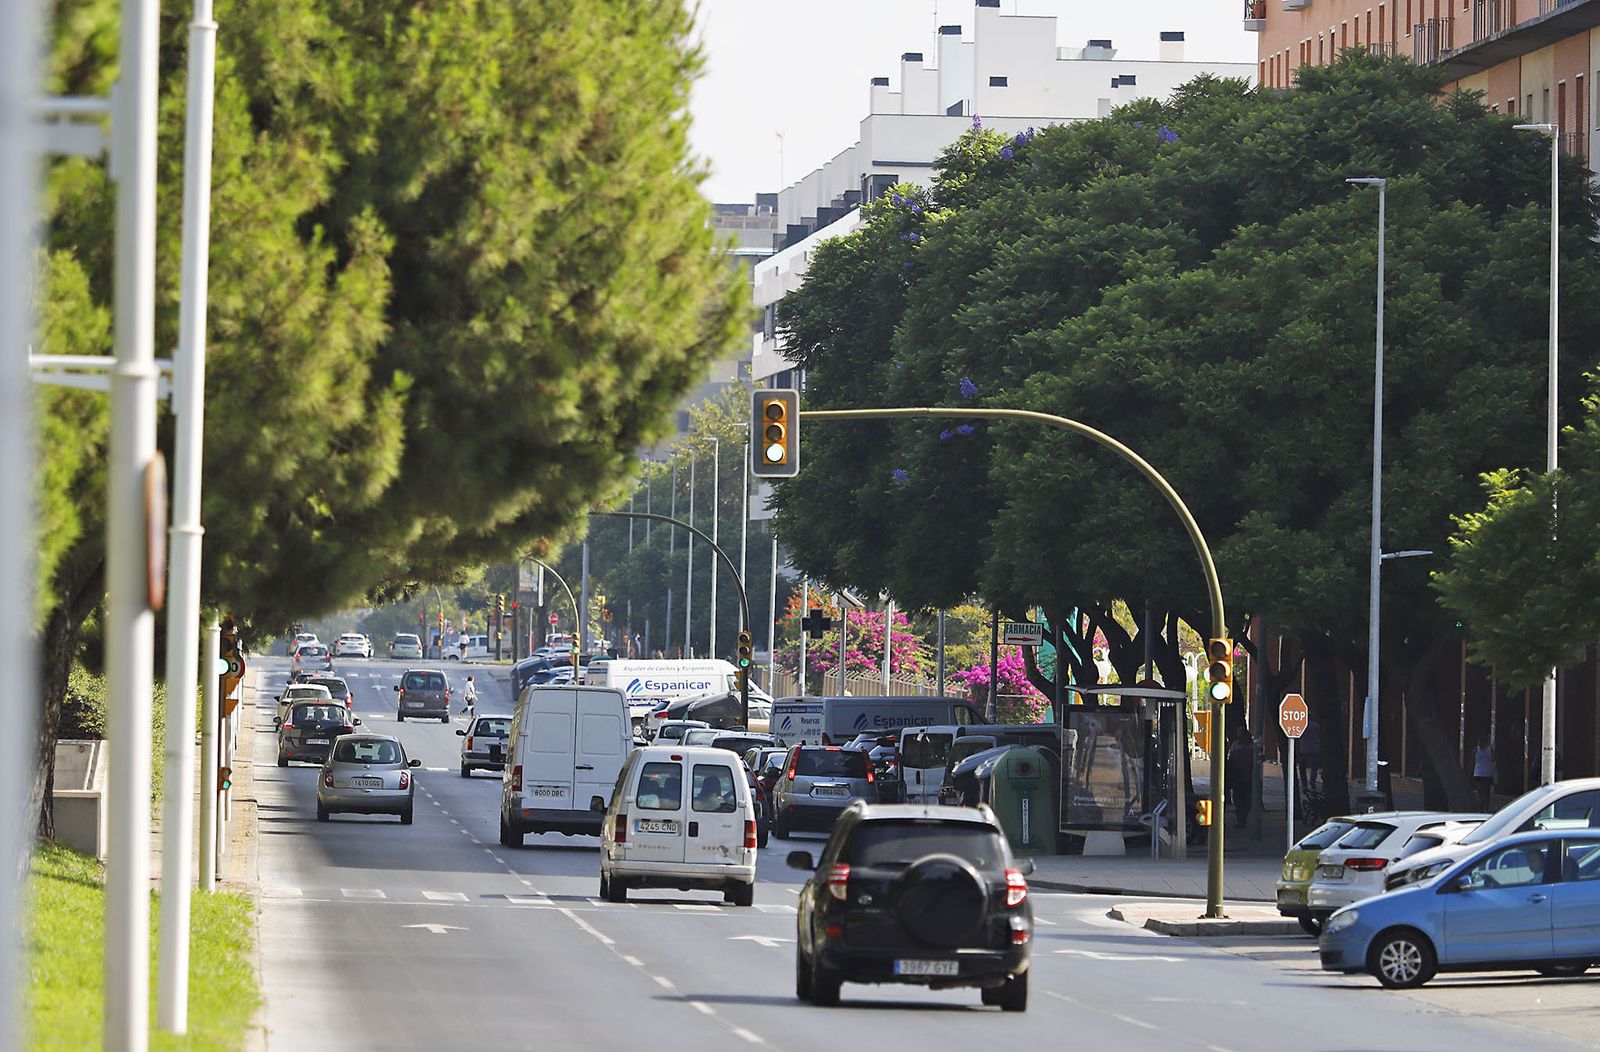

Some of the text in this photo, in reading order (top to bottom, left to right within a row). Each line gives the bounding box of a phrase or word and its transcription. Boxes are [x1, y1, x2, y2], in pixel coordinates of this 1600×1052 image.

[1005, 624, 1042, 635] FARMACIA
[645, 680, 711, 692] Espanicar
[1283, 710, 1306, 721] STOP
[873, 715, 935, 729] Espanicar
[640, 822, 677, 832] 4245 CND
